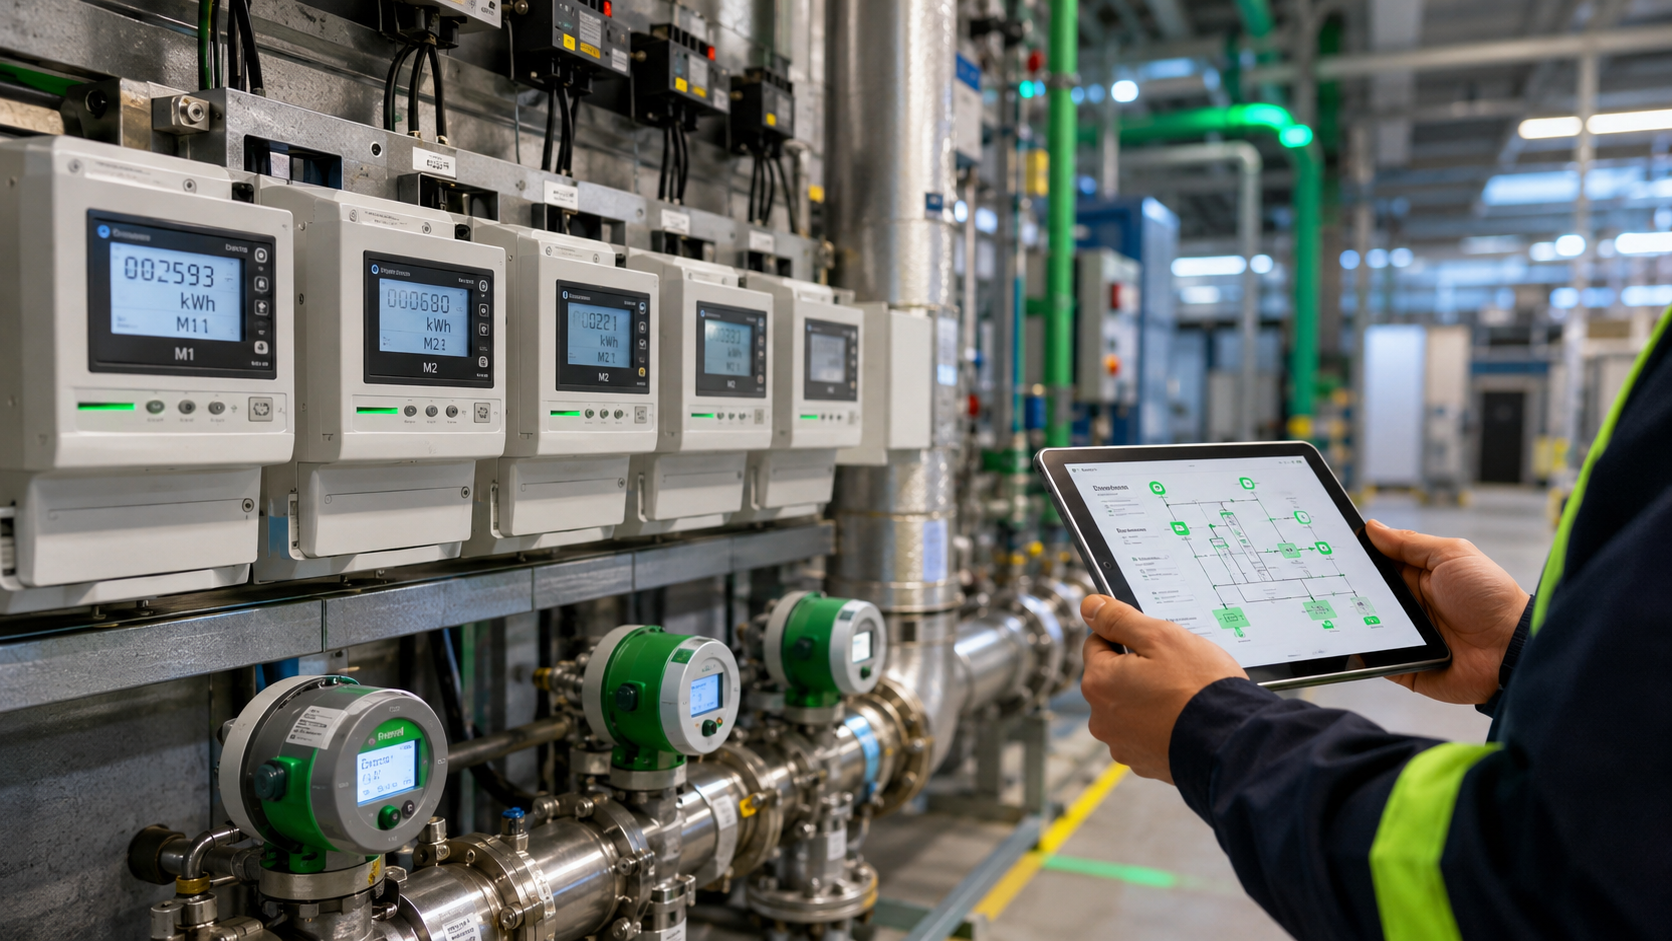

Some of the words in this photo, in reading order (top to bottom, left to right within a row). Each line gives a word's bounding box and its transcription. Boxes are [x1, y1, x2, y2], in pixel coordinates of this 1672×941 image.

[125, 256, 214, 288] 002593
[181, 292, 215, 312] kWh
[387, 288, 450, 314] 000680
[426, 317, 451, 333] kWh
[600, 334, 619, 349] kWh
[175, 347, 194, 361] M1
[423, 362, 438, 374] M2
[598, 373, 610, 382] M2
